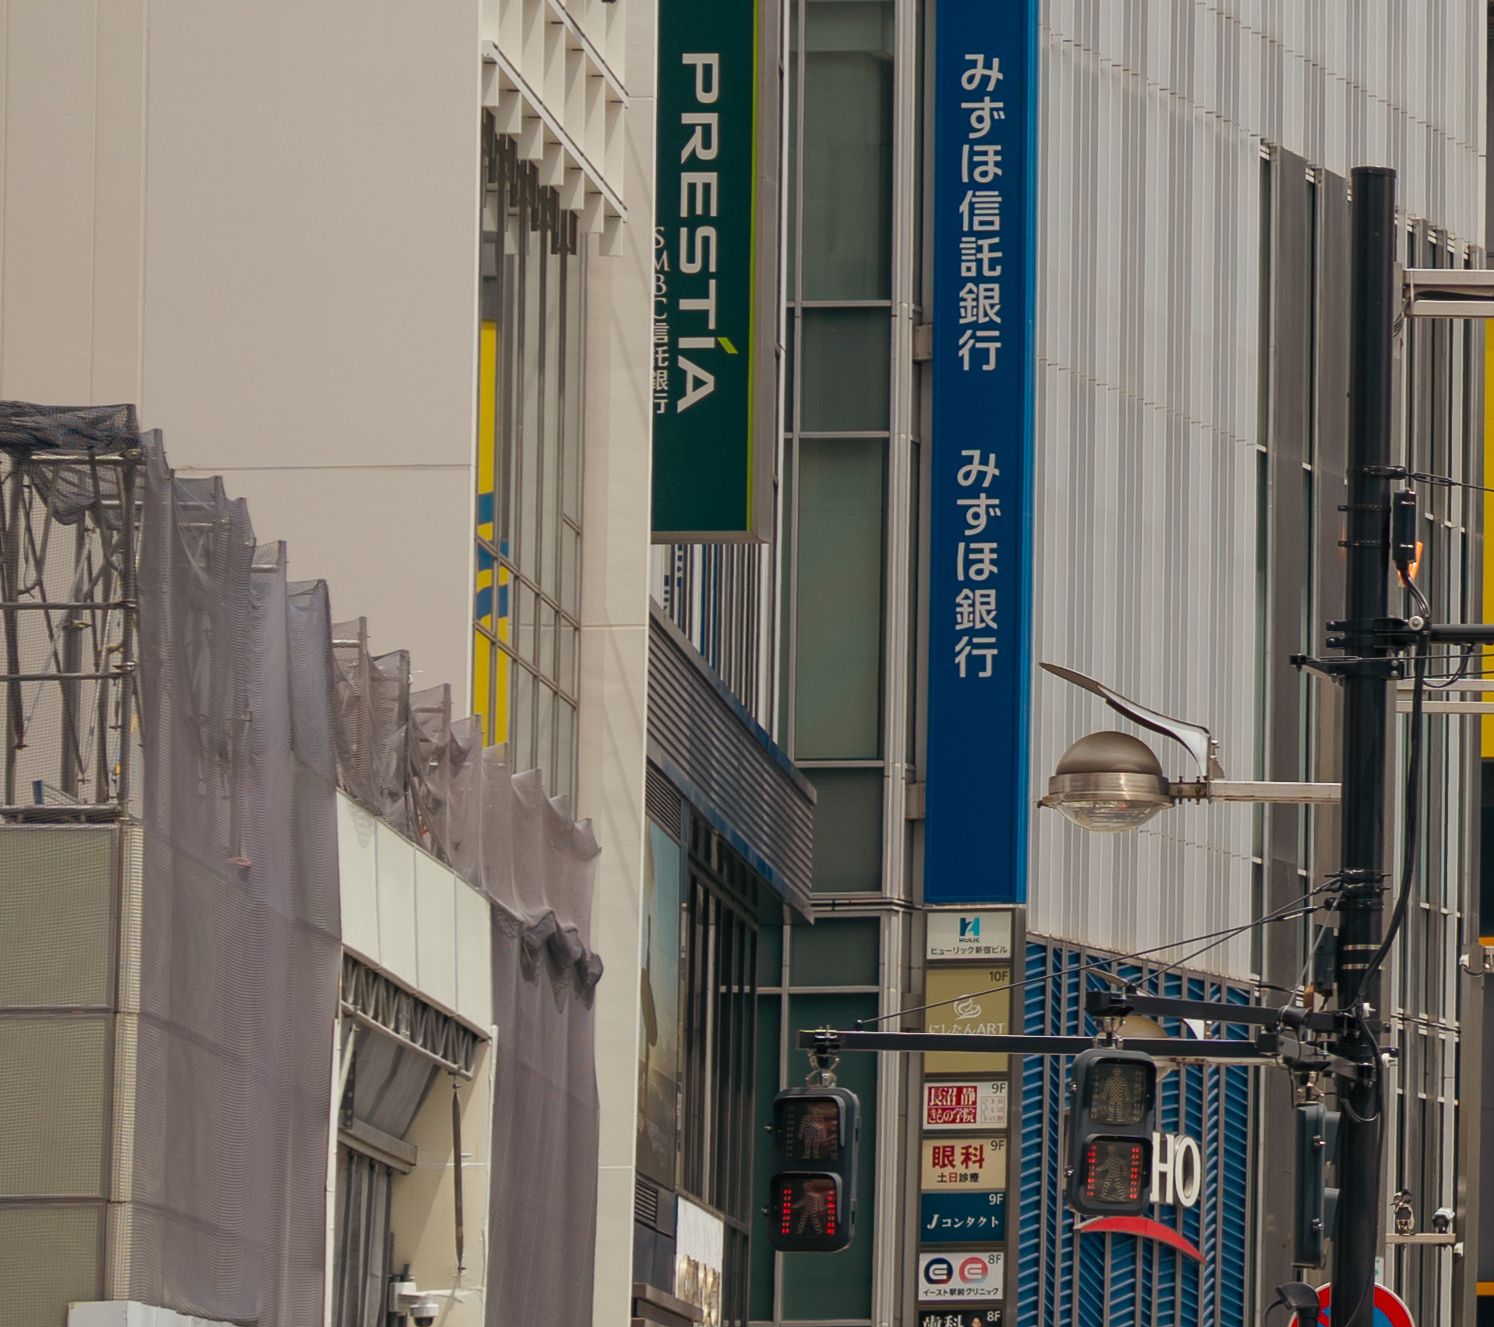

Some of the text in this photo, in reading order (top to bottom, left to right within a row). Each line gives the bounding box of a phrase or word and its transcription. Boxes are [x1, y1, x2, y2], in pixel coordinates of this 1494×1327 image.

[958, 53, 1005, 371] みずほ信託銀行
[954, 449, 1001, 678] みずほ銀行
[930, 945, 1009, 956] ヒューリック新宿ビル
[989, 971, 1009, 983] 10F
[991, 1082, 1007, 1094] 9F
[928, 1108, 976, 1124] きもの学院
[990, 1140, 1005, 1151] 9F
[931, 1144, 985, 1170] 眼科
[937, 1172, 980, 1184] 土日診療
[988, 1194, 1004, 1205] 9F
[988, 1254, 1002, 1265] 8F
[923, 1287, 1000, 1297] イースト駅前クリニック
[986, 1311, 1001, 1322] 8F
